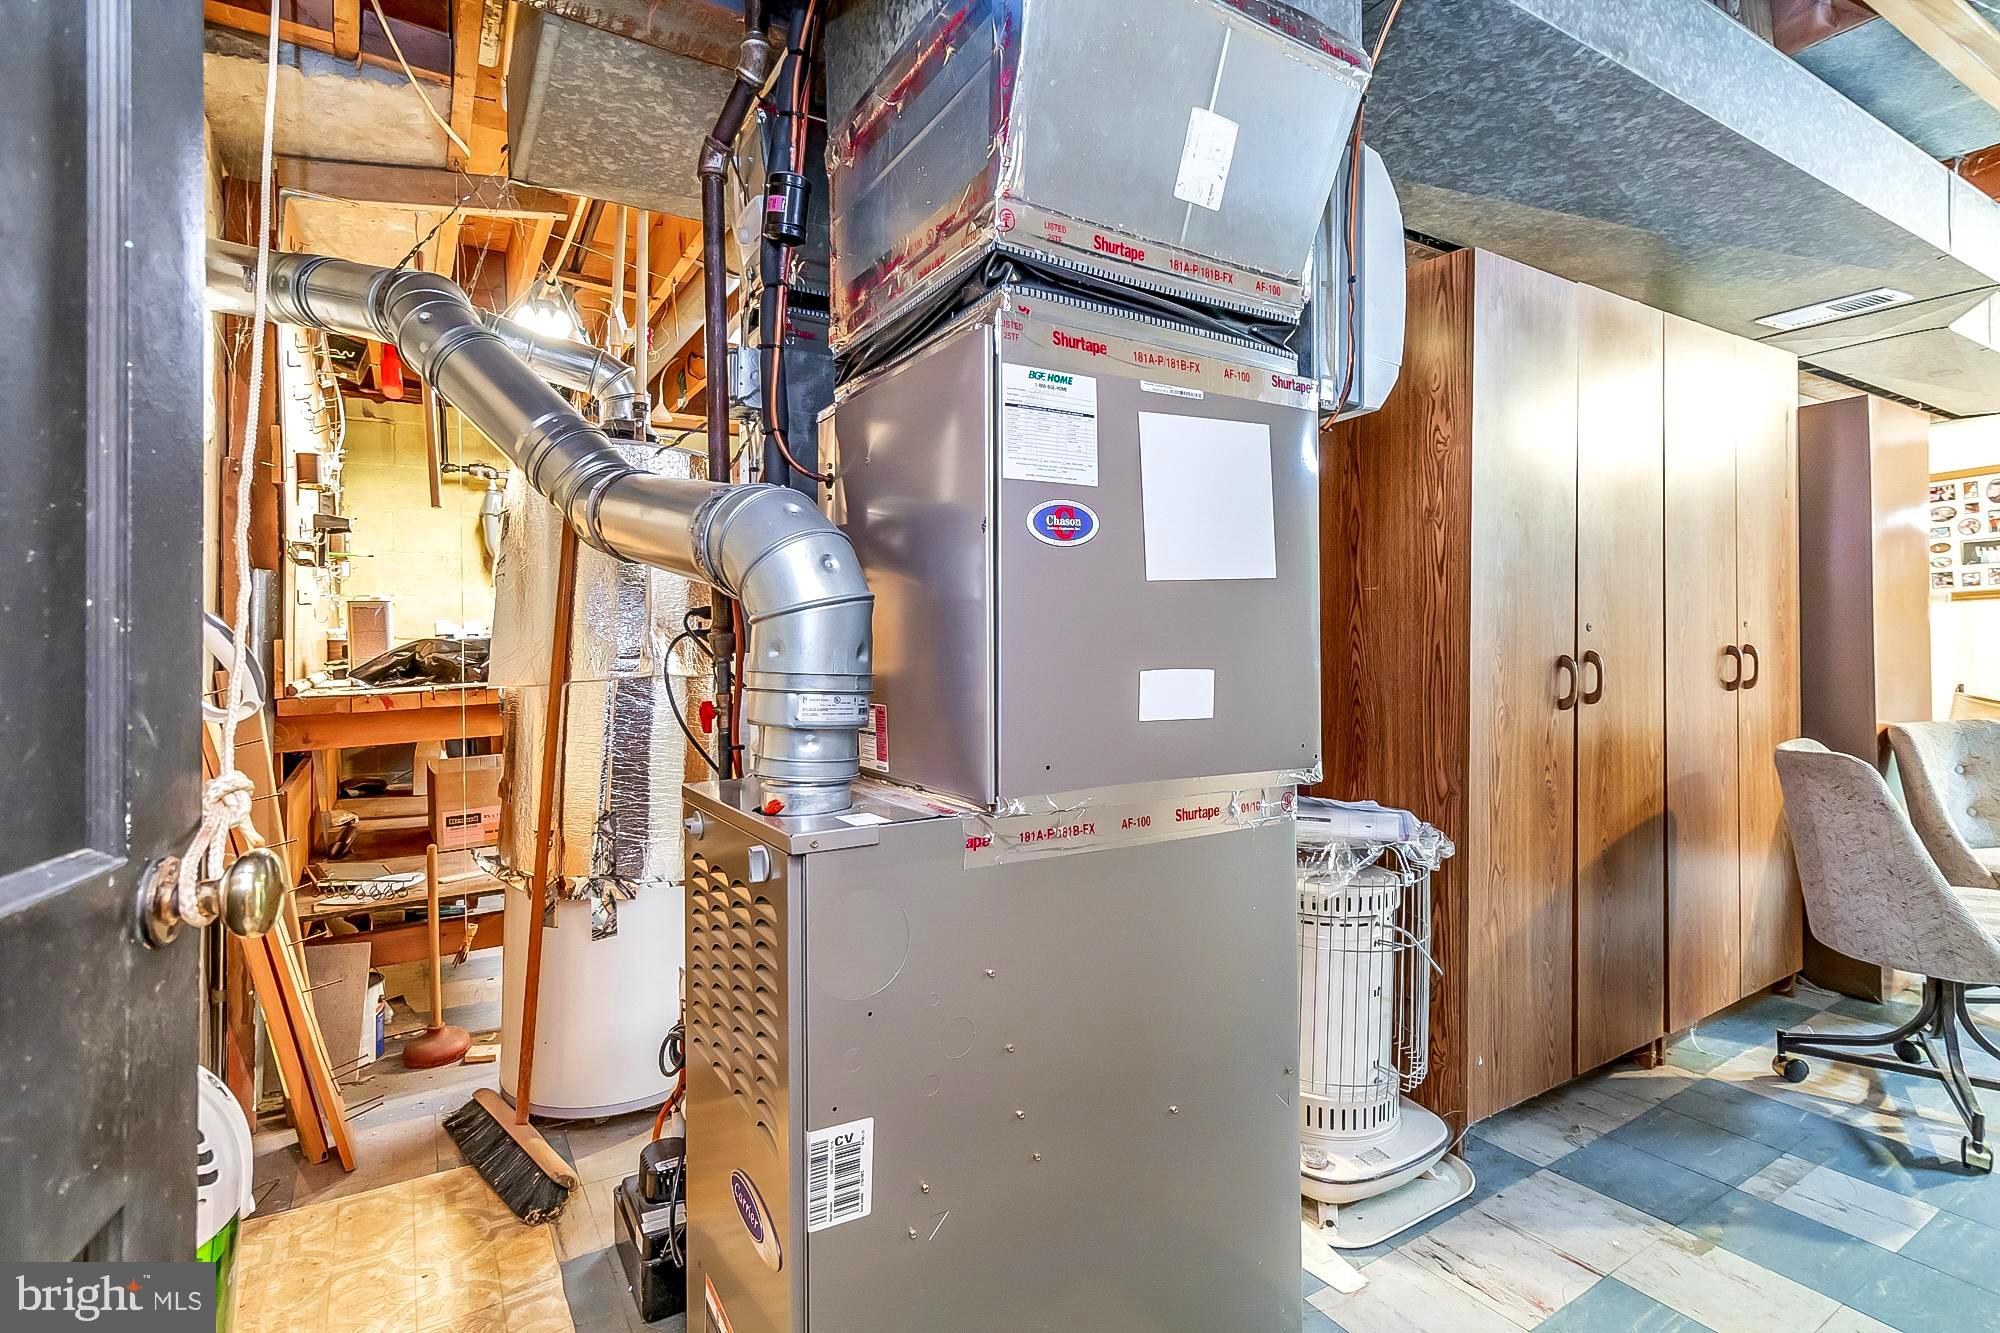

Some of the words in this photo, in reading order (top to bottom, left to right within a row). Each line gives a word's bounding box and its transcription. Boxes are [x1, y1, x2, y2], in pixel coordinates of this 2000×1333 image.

[1319, 36, 1361, 68] Shurtape
[1044, 220, 1067, 234] LISTED
[1093, 234, 1145, 262] Shurtape
[1255, 280, 1281, 296] AF-100
[1003, 332, 1020, 342] 25TF
[1052, 330, 1107, 356] Shurtape
[1224, 368, 1250, 383] AF-100
[1271, 374, 1311, 395] Shurtape
[1028, 370, 1046, 381] BGE
[1047, 373, 1073, 385] HOME
[1046, 514, 1082, 527] Chason
[1175, 806, 1220, 822] Shurtape
[1121, 815, 1151, 830] AF-100
[834, 1132, 854, 1146] CV
[733, 1182, 759, 1229] Carrier
